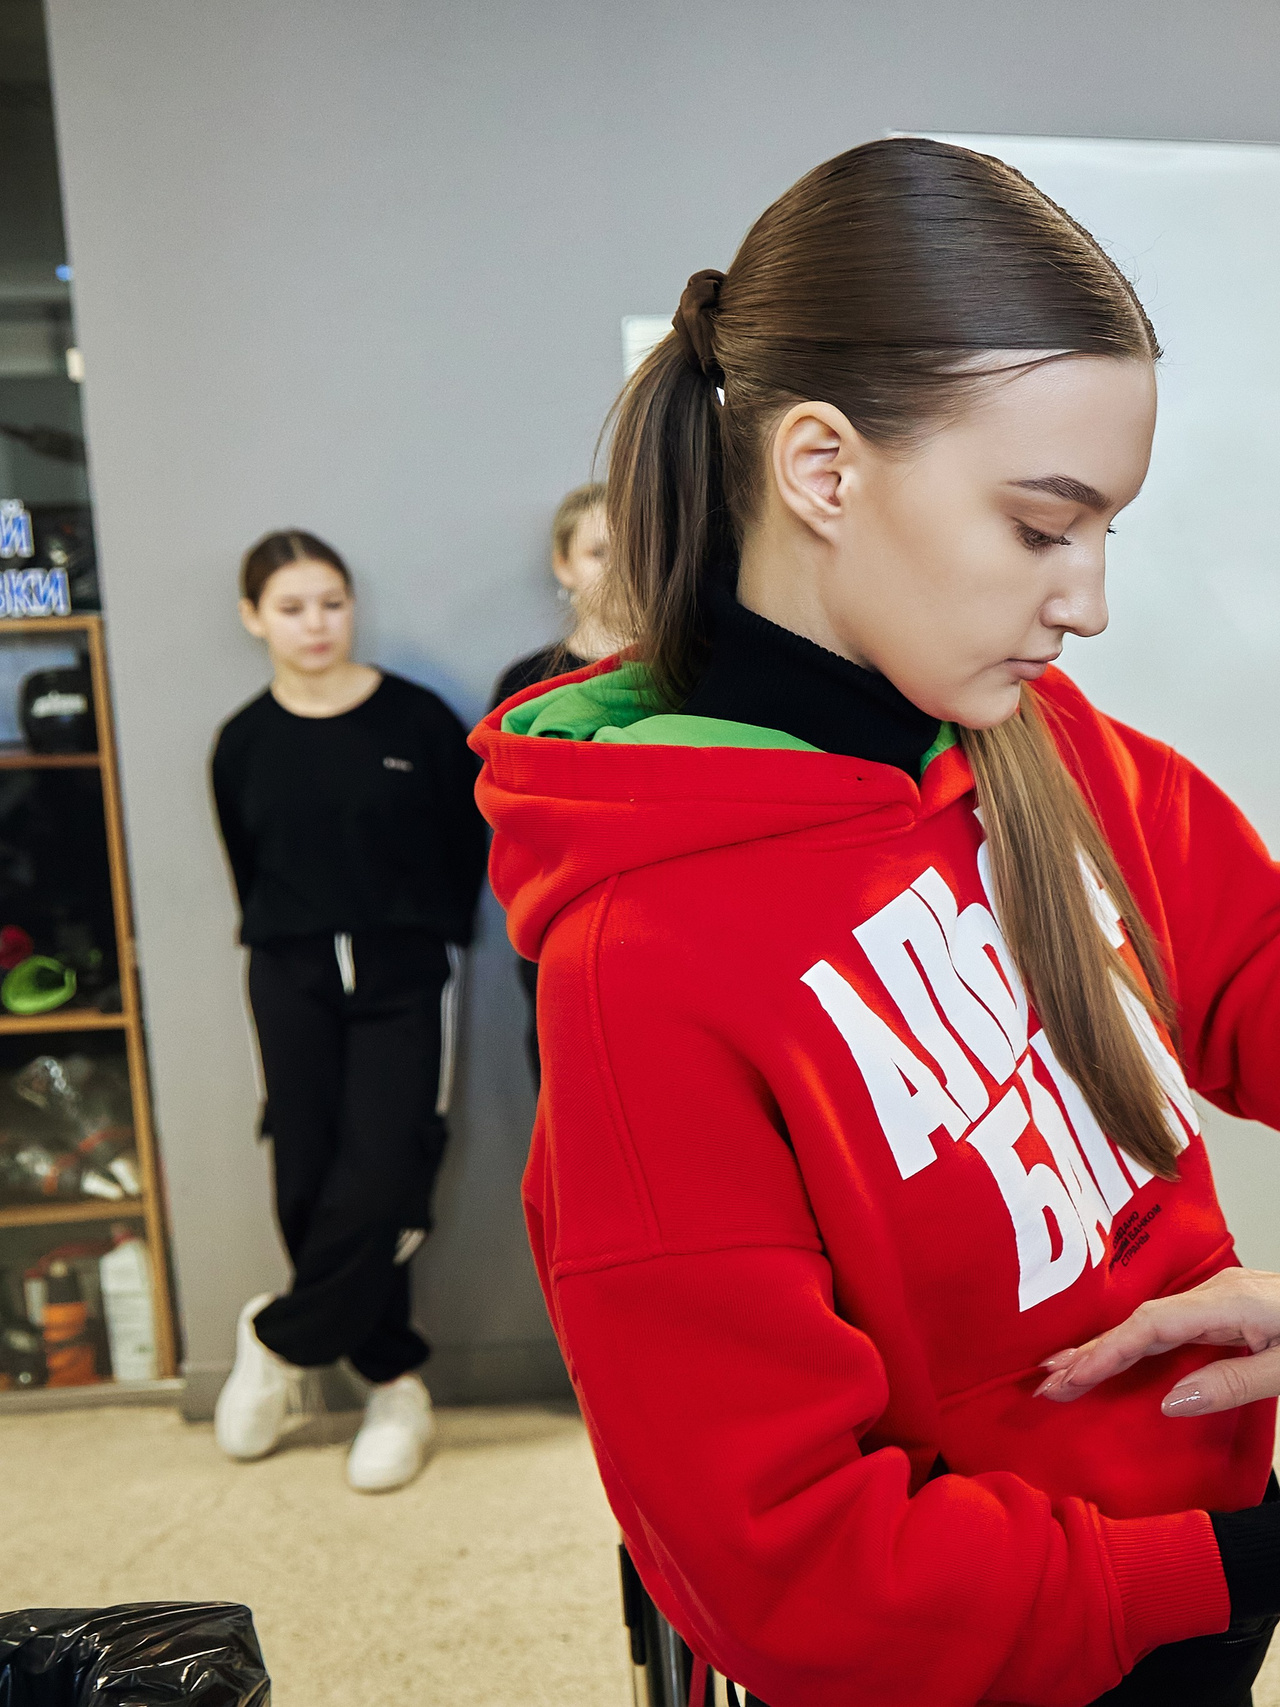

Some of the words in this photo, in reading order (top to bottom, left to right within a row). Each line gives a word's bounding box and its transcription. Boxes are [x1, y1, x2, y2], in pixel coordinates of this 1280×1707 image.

[0, 567, 71, 617] КИ
[800, 807, 1125, 1180] АЛЬ
[1128, 1204, 1161, 1240] БАНКОМ
[1121, 1232, 1150, 1267] СТРАНЫ
